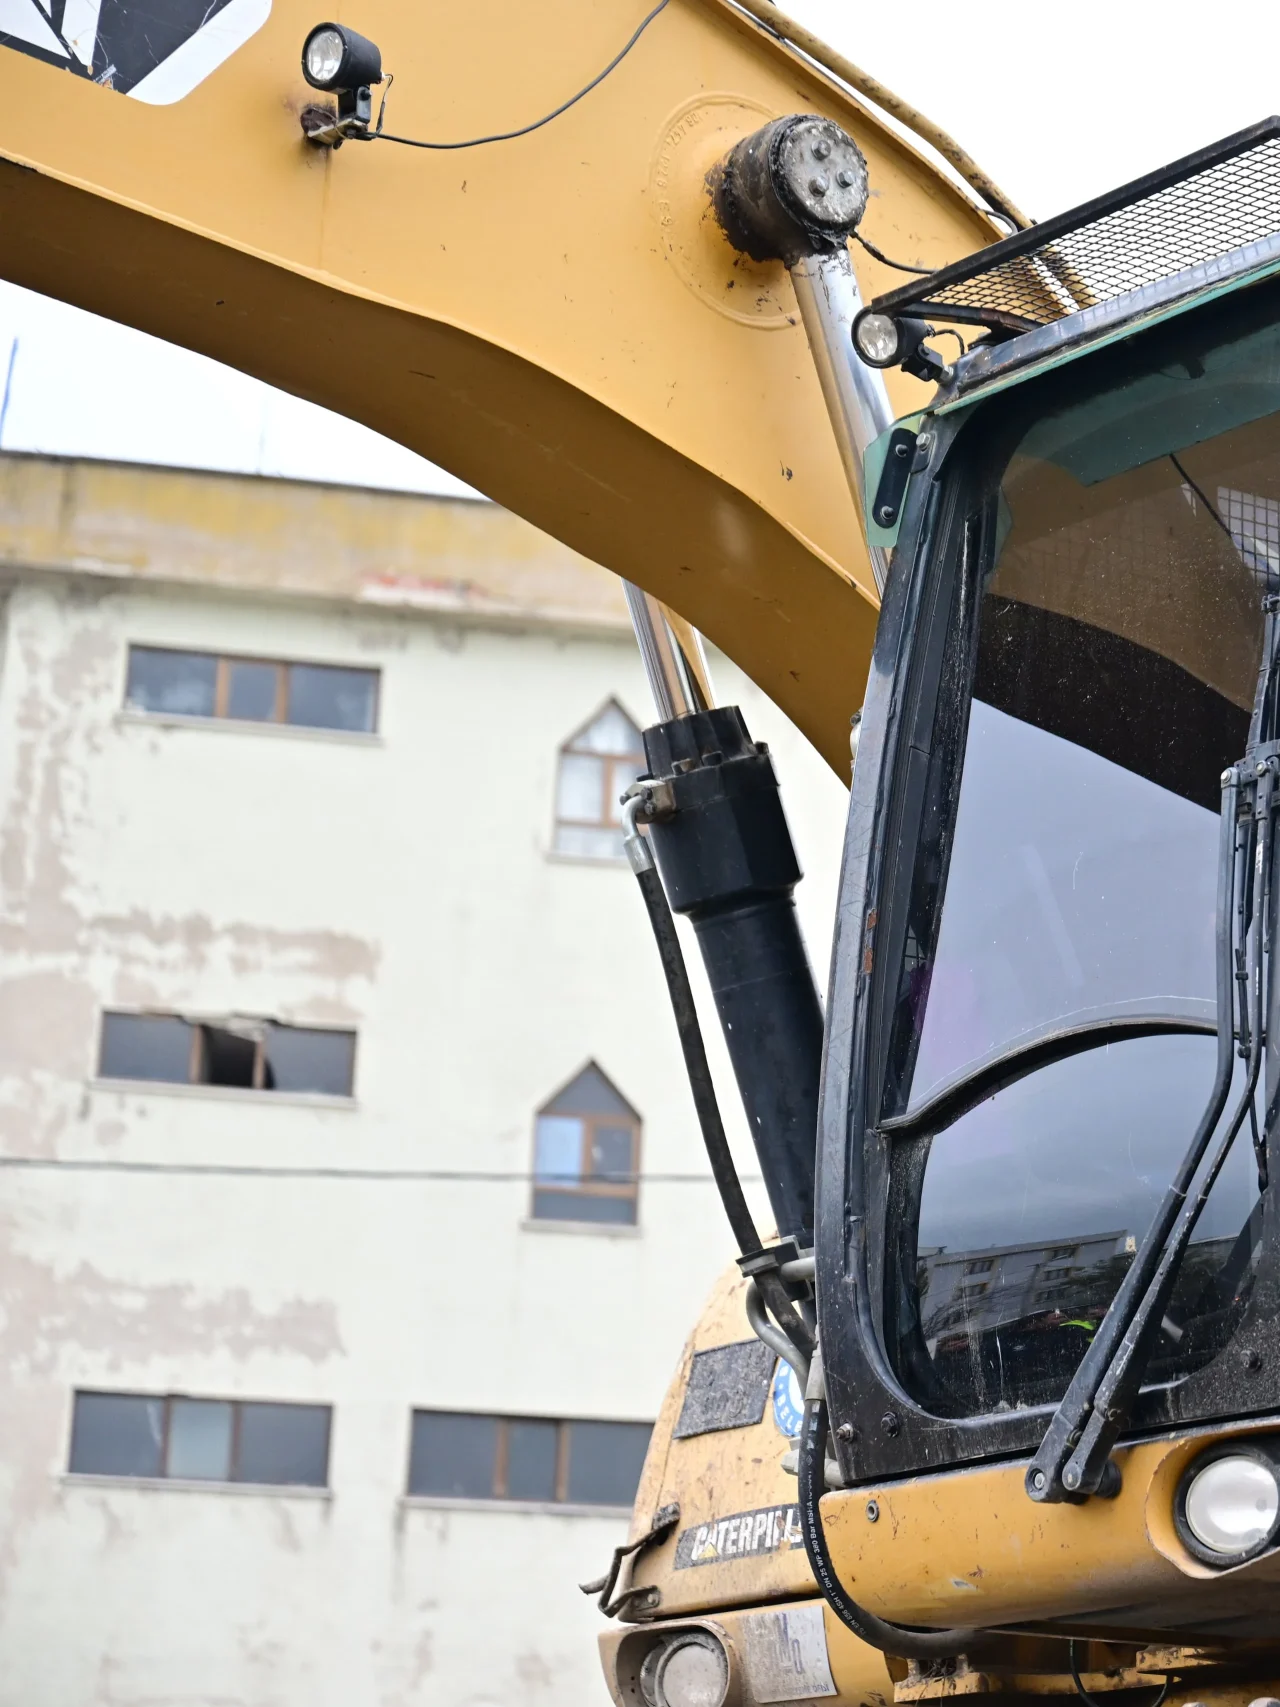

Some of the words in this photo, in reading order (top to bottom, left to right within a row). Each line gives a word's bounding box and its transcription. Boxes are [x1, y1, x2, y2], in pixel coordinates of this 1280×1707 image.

[809, 1525, 817, 1539] Bar
[811, 1540, 820, 1553] 380
[816, 1554, 824, 1568] WP
[820, 1567, 828, 1577] 25
[823, 1577, 833, 1589] DN
[833, 1596, 845, 1610] 4SH
[841, 1609, 853, 1621] 856
